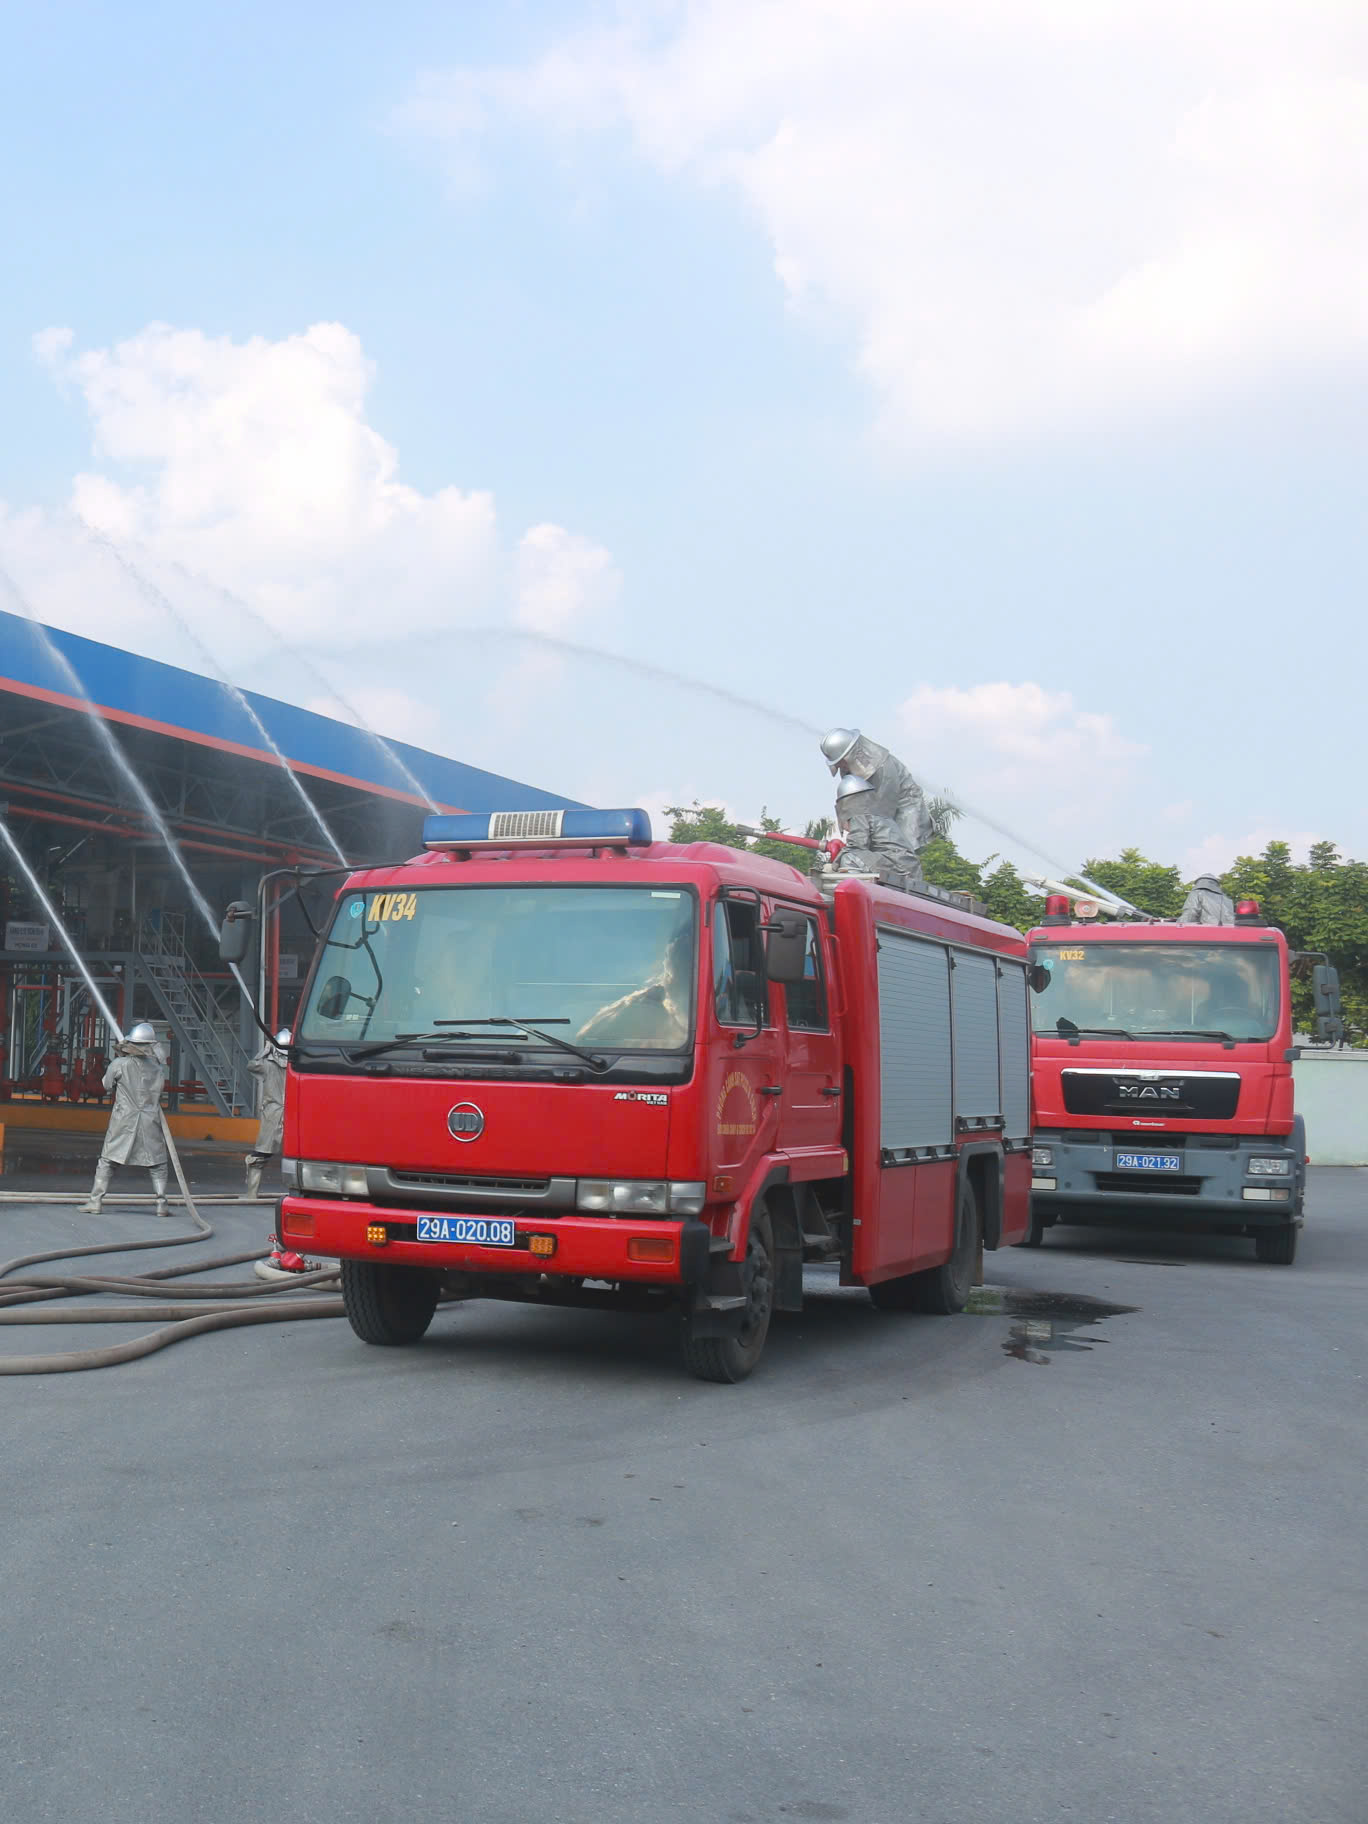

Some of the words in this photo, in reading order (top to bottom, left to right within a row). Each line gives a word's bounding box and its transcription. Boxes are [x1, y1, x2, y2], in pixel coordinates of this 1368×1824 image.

[368, 893, 416, 921] KV34
[1060, 950, 1085, 961] KV32
[614, 1091, 668, 1102] MORITA
[1119, 1086, 1179, 1099] MAN
[1119, 1156, 1177, 1169] 29A-021.32
[420, 1219, 511, 1242] 29A-020.08
